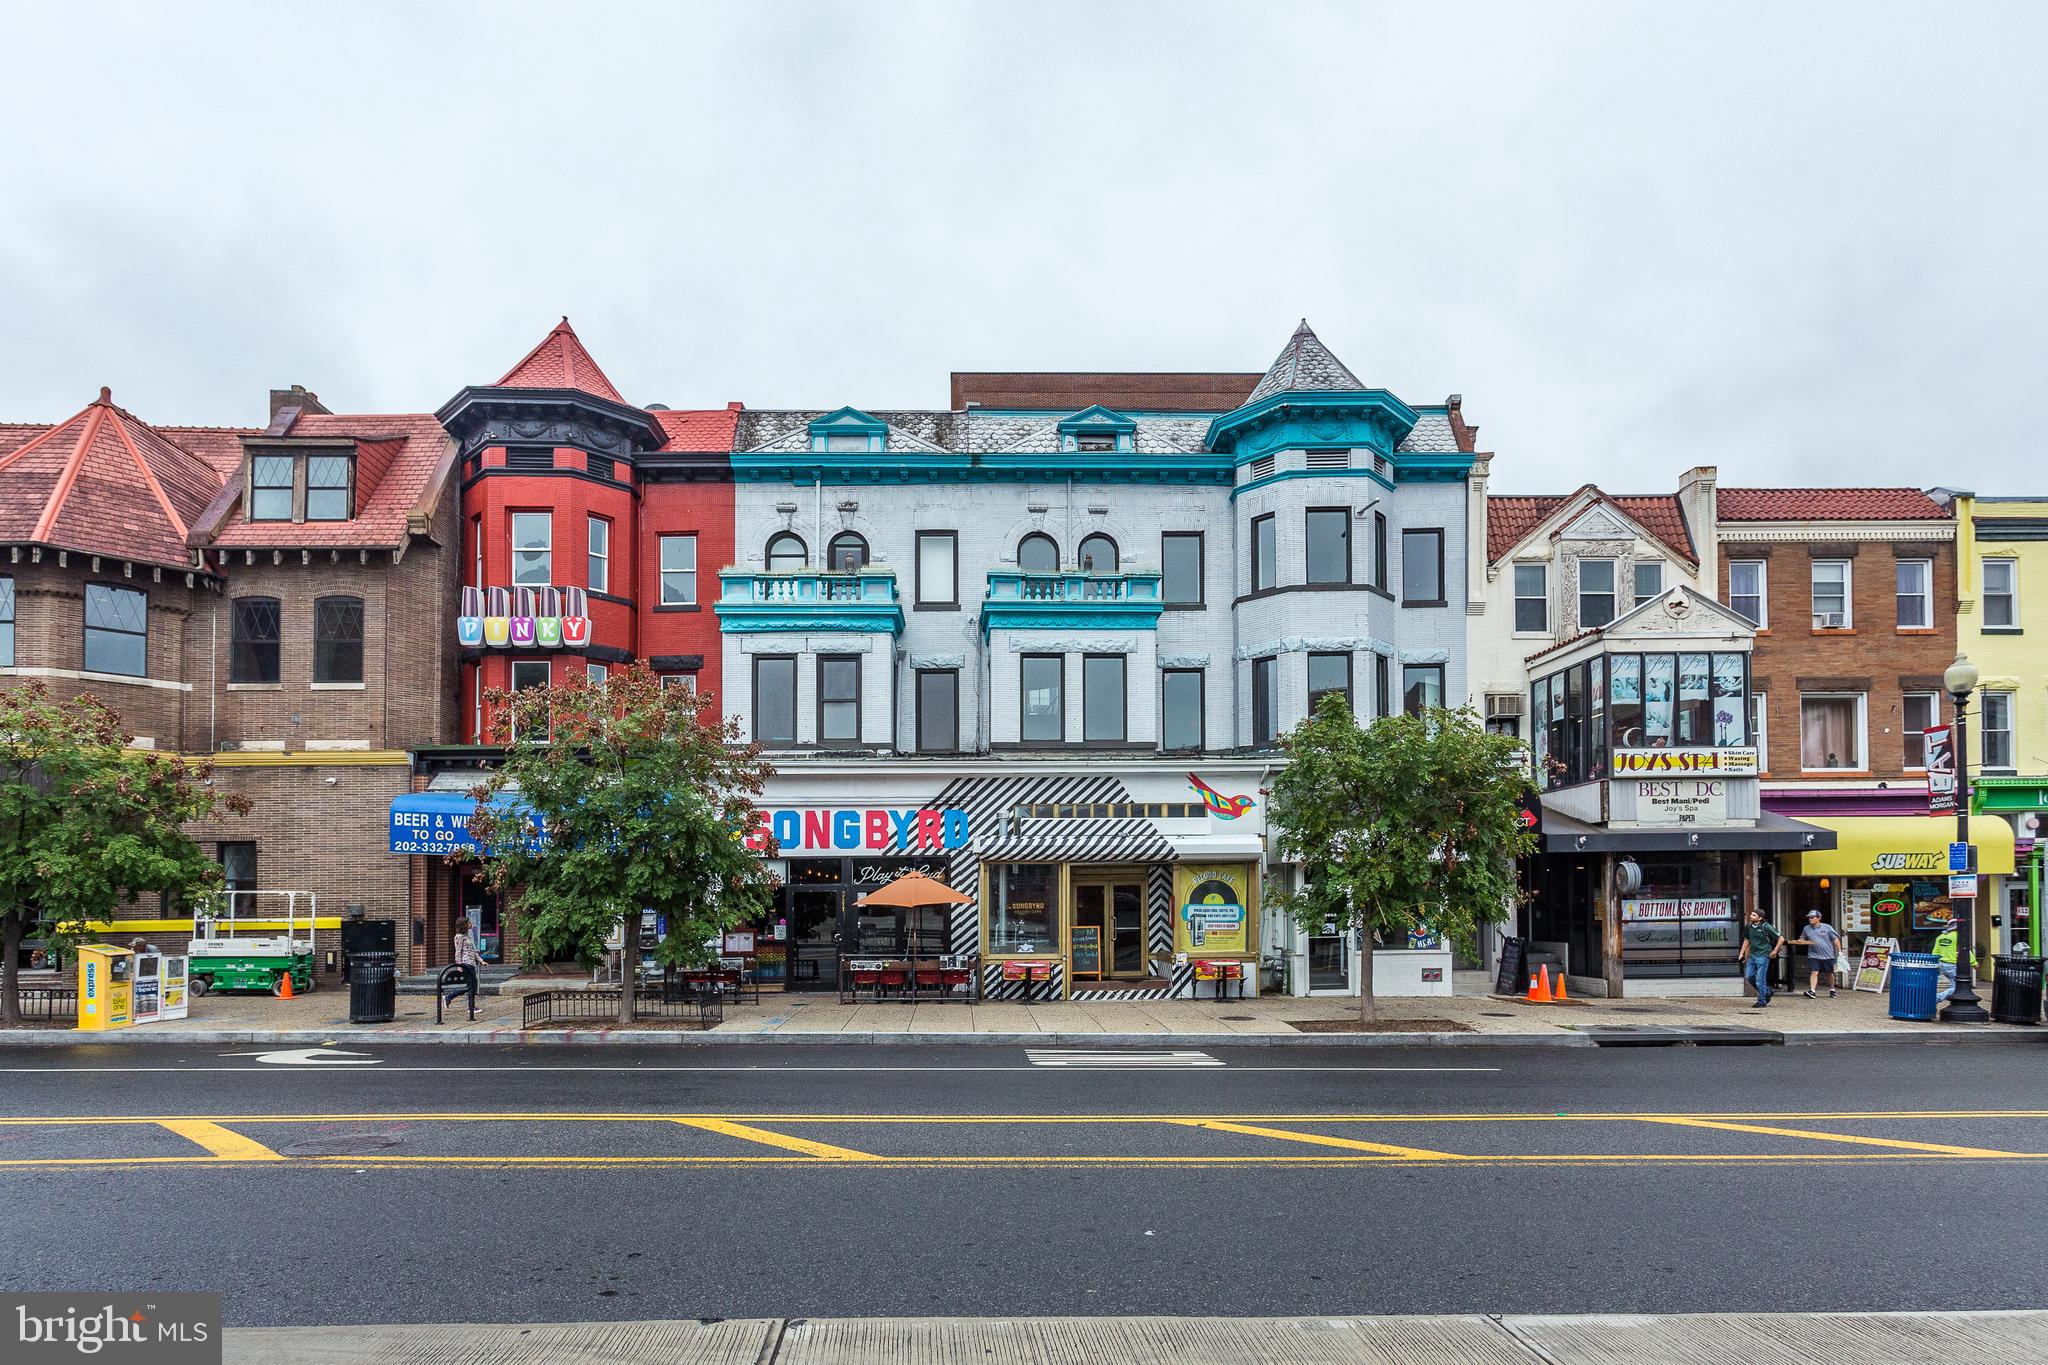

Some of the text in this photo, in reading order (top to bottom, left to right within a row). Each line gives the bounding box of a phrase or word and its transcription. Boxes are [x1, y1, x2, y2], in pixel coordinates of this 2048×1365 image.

[464, 621, 582, 638] PINKY
[1615, 751, 1720, 773] JOY'S SPA
[1927, 735, 1955, 794] EAT
[1638, 781, 1684, 797] BEST
[1929, 802, 1954, 810] MORGAN
[1931, 795, 1953, 804] ADAMS
[394, 812, 429, 827] BEER
[435, 814, 444, 828] &
[1679, 814, 1696, 822] PAPER
[412, 829, 454, 841] TO GO
[746, 809, 969, 850] SONGBYRD
[1871, 850, 1945, 871] SUBWAY
[853, 865, 894, 885] Play
[1693, 901, 1727, 917] BRUNCH
[1877, 903, 1901, 912] OPEN
[87, 962, 96, 998] express
